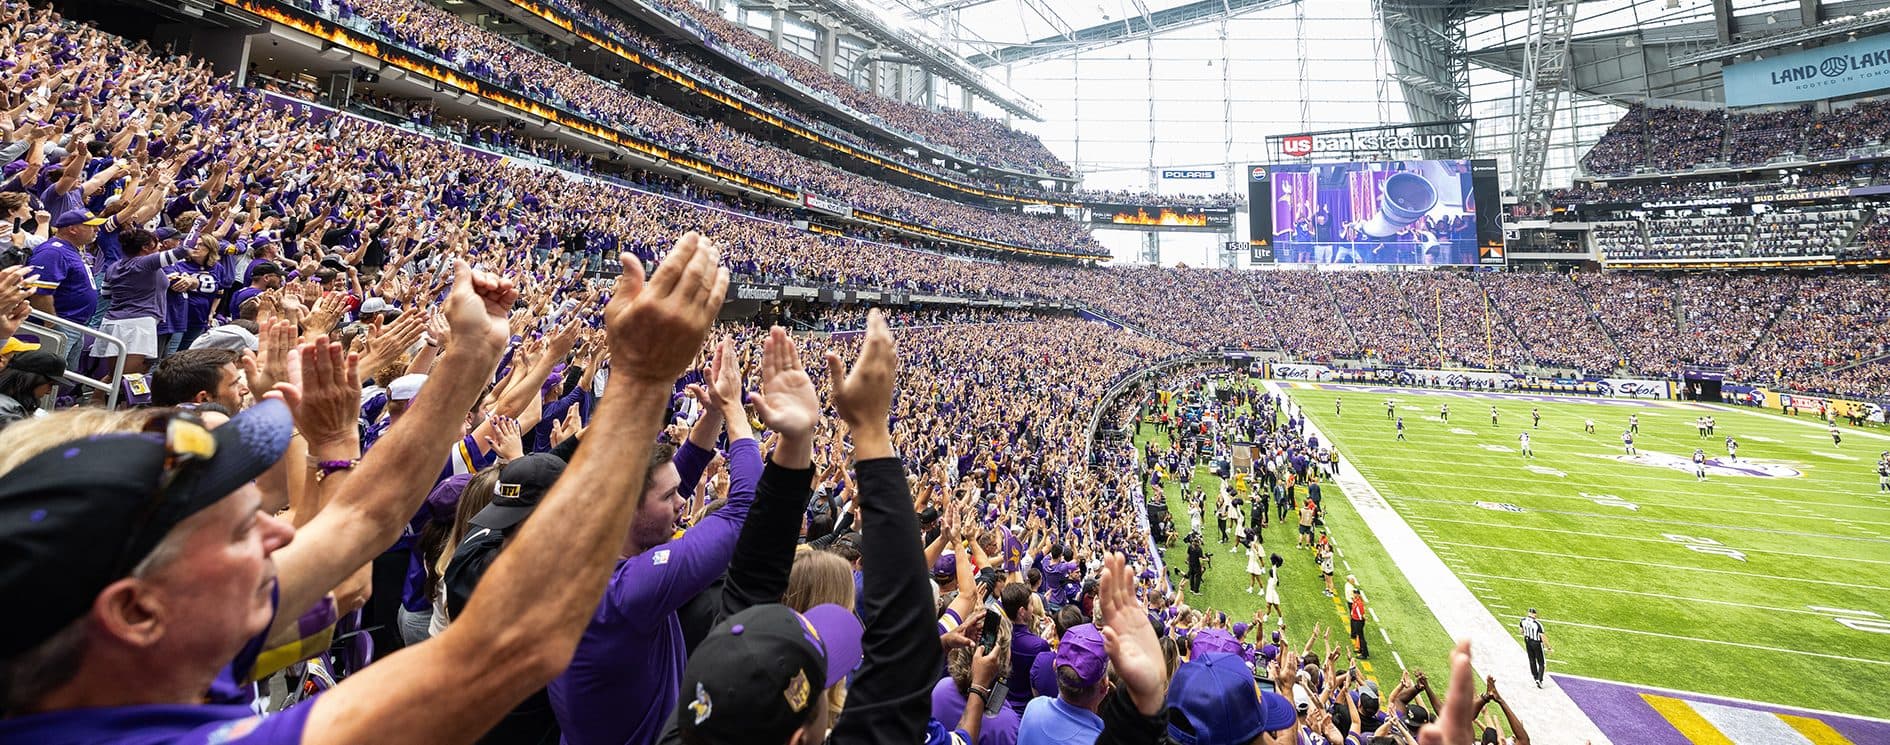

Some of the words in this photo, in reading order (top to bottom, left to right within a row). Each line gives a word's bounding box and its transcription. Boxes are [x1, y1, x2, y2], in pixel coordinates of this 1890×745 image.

[1771, 64, 1818, 85] LAND
[1796, 79, 1837, 90] ROOTED
[1754, 194, 1774, 203] BUD
[1775, 192, 1810, 202] GRANT
[1812, 188, 1851, 199] FAMILY
[1229, 242, 1248, 250] 15:00
[1254, 248, 1271, 259] Lite
